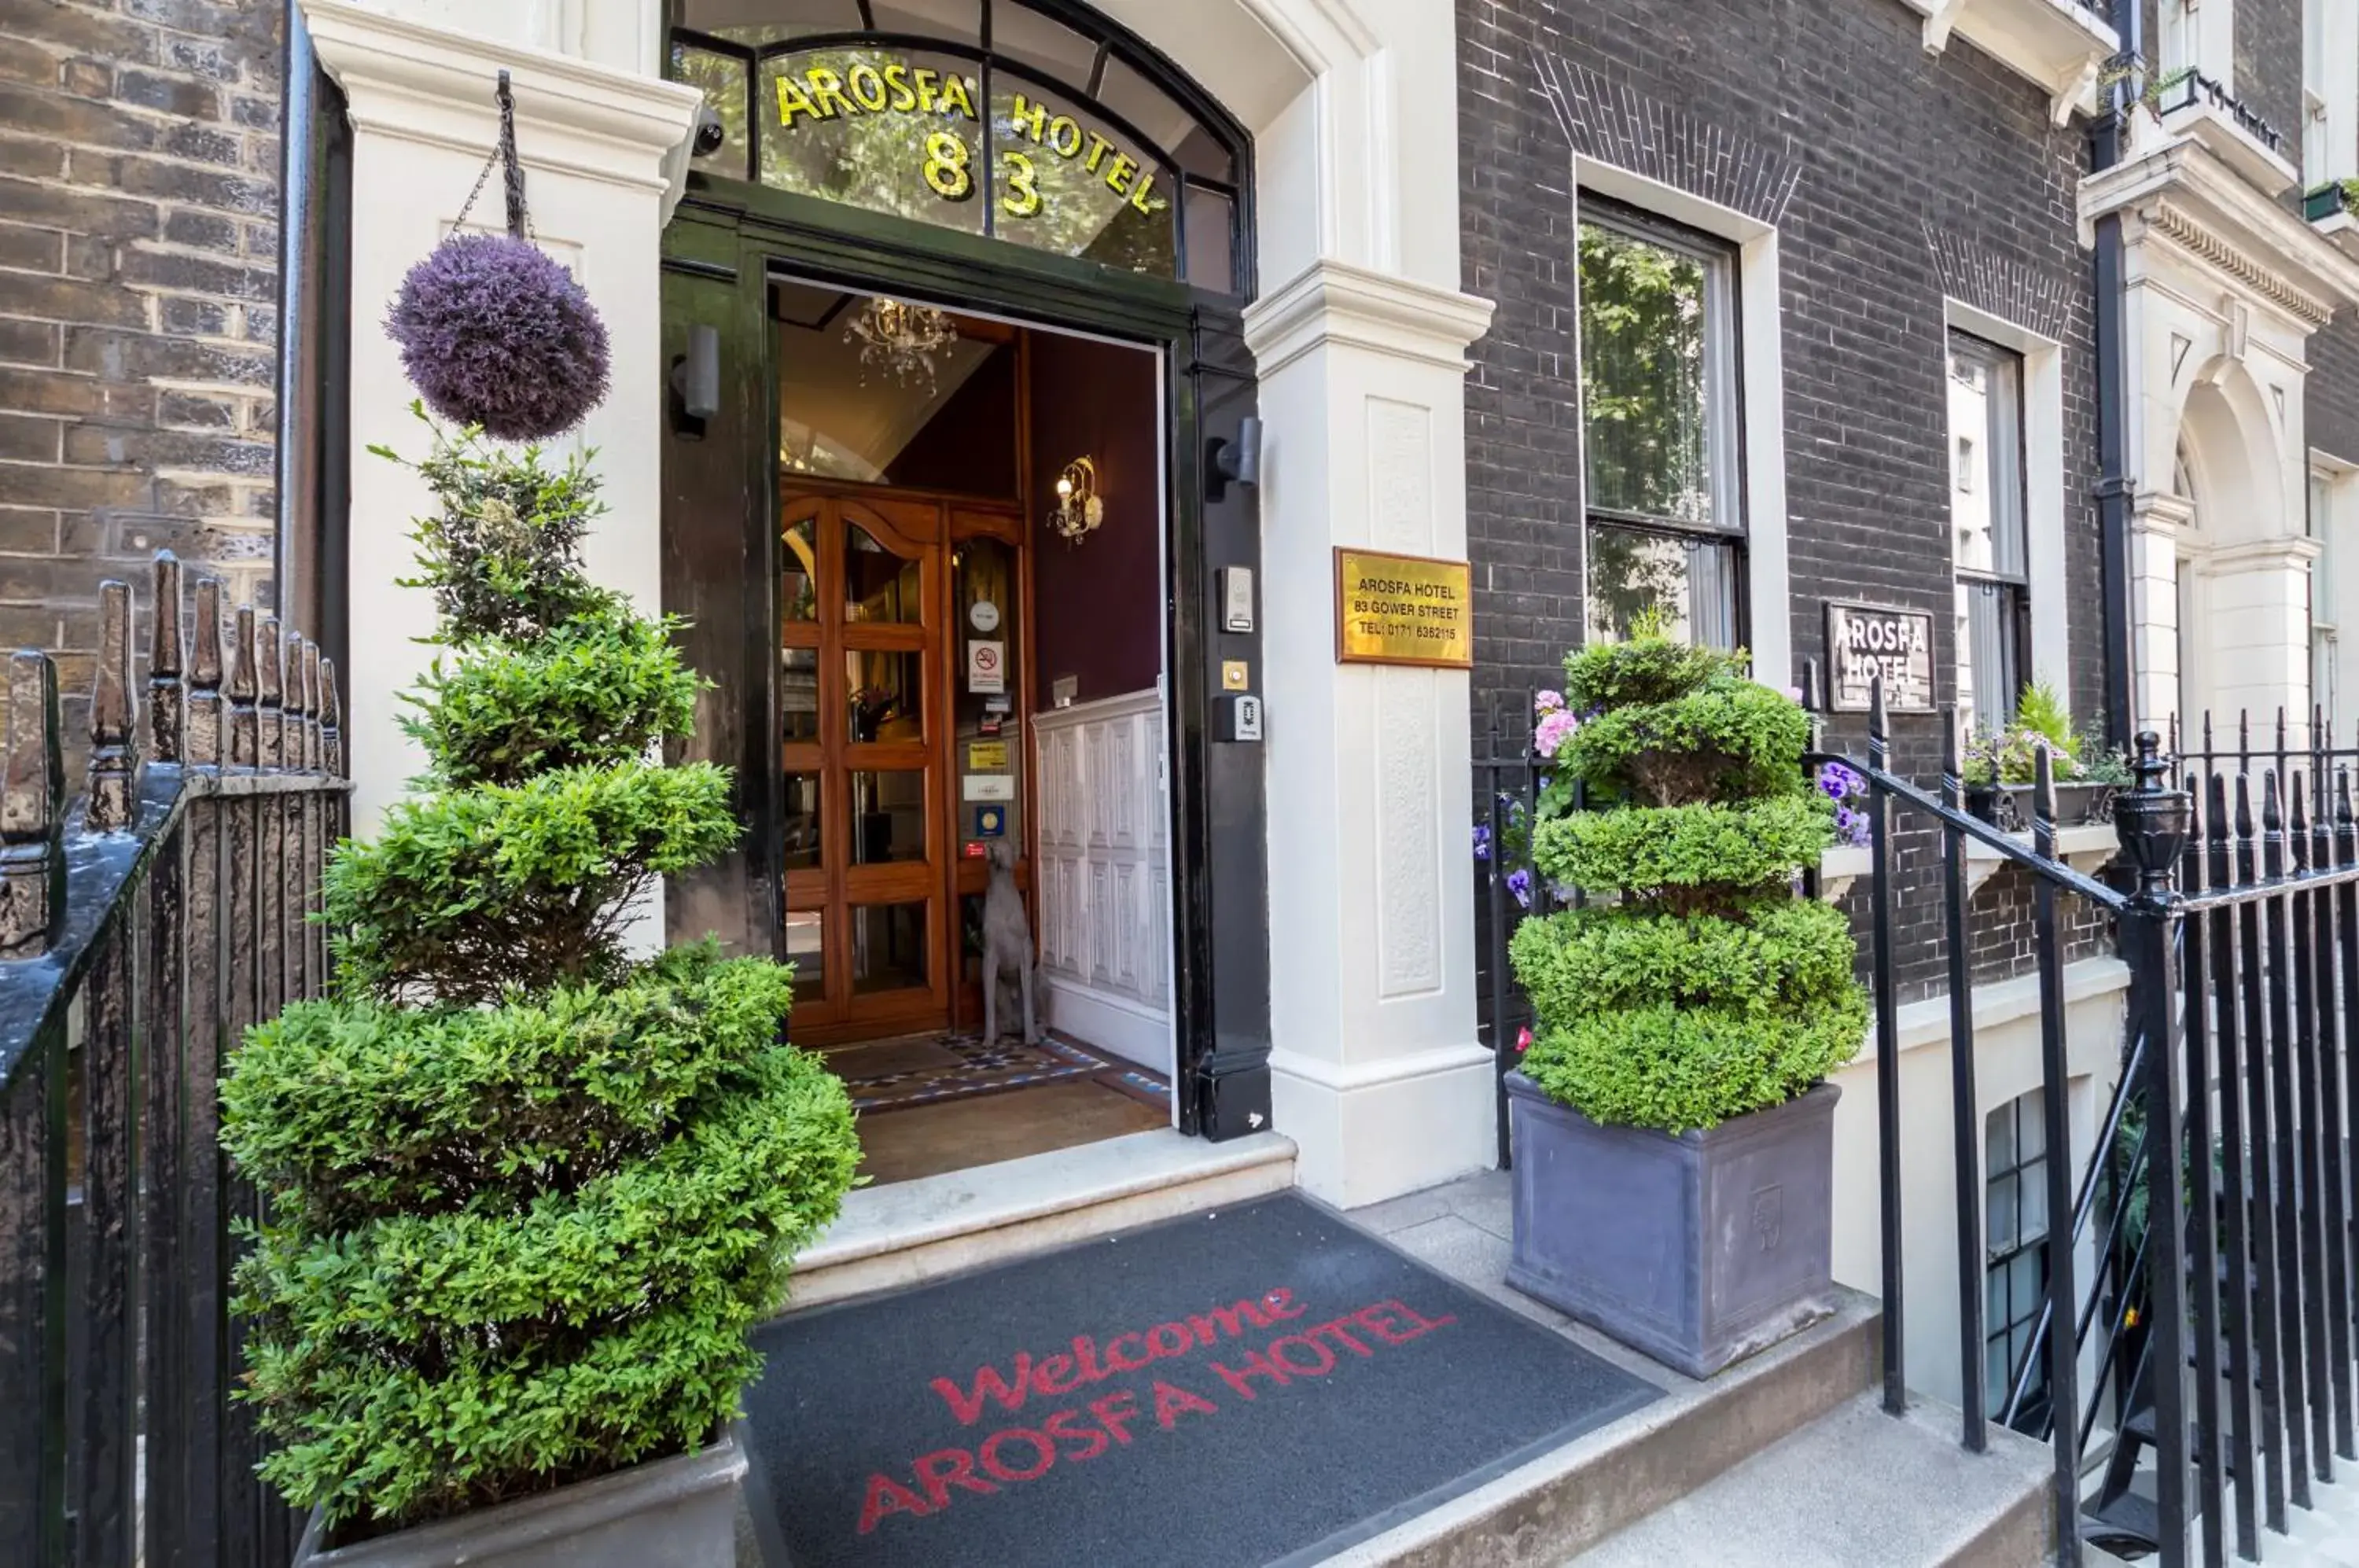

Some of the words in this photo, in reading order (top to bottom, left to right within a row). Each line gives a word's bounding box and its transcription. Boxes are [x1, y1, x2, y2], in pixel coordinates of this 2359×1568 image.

[775, 62, 980, 128] AROSFA
[1011, 93, 1168, 216] HOTEL
[1359, 578, 1411, 596] AROSFA
[1415, 584, 1456, 600] HOTEL
[1354, 600, 1368, 613] 83
[1371, 602, 1415, 617] GOWER
[1418, 605, 1459, 620] STREET
[1388, 624, 1411, 638] 0171
[1835, 617, 1924, 652] AROSFA
[1847, 654, 1912, 685] HOTEL
[930, 1287, 1308, 1426] Welcome
[857, 1379, 1217, 1535] AROSFA
[1211, 1299, 1456, 1400] HOTEL
